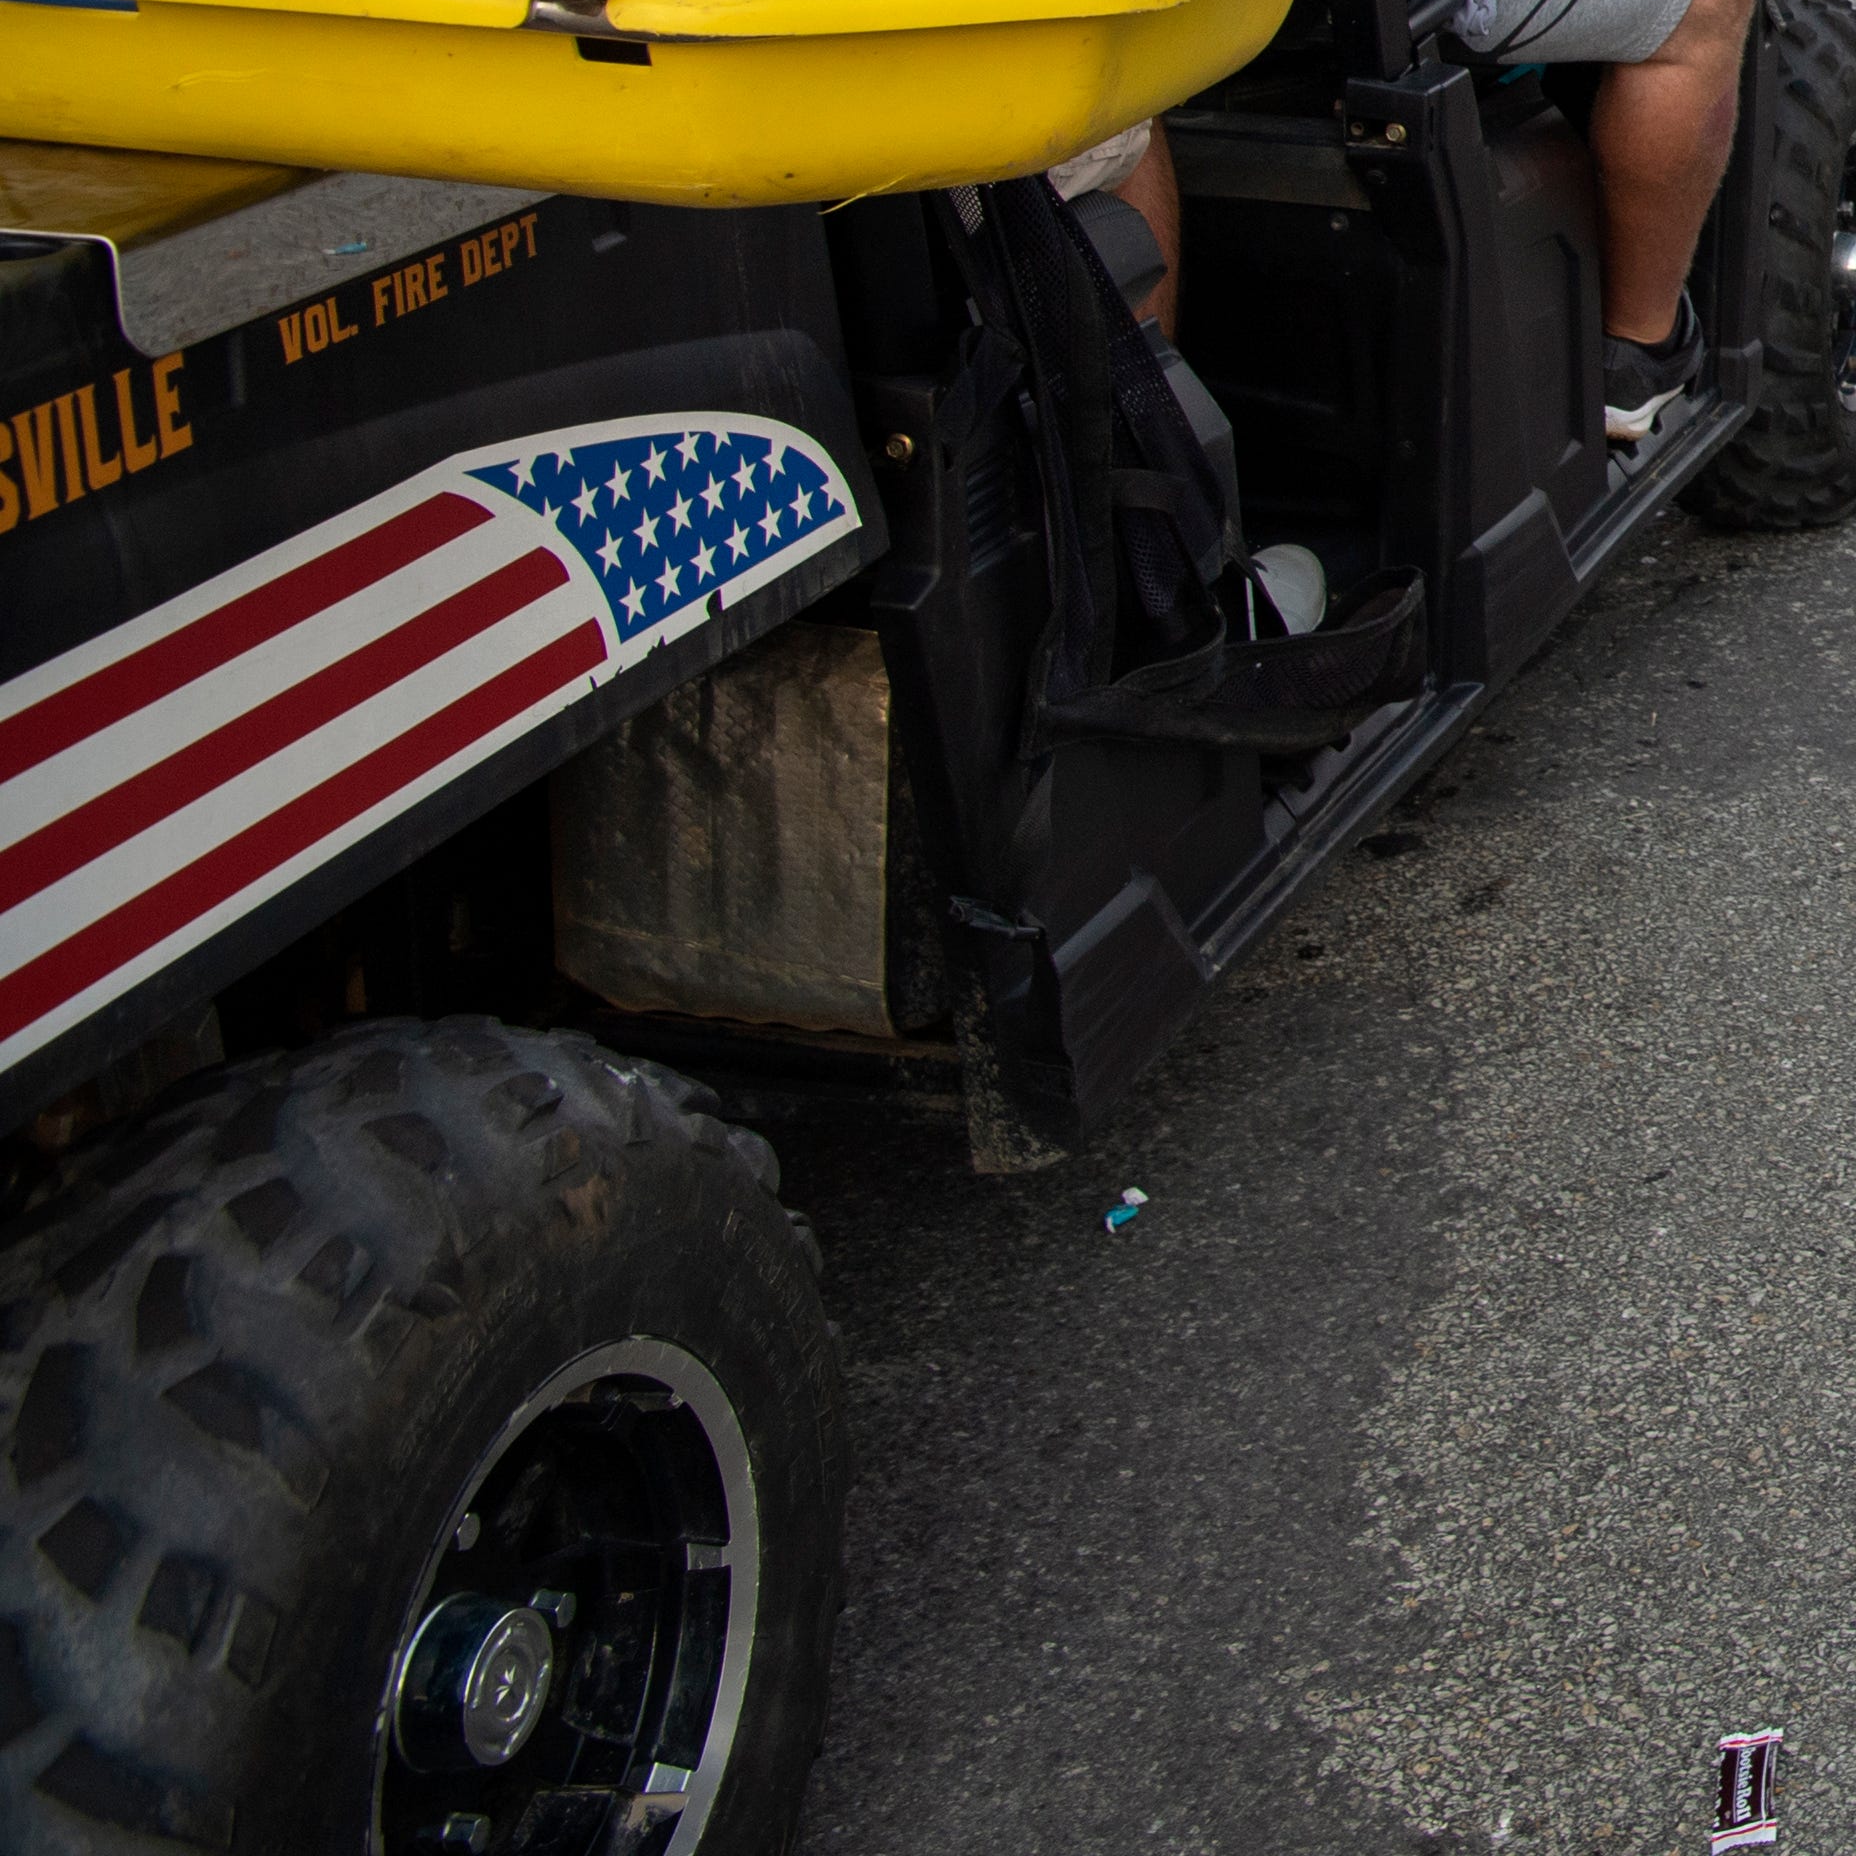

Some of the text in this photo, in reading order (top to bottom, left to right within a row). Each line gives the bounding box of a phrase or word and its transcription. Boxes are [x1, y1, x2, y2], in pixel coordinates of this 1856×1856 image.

[278, 296, 359, 366] VOL.
[371, 252, 449, 328] FIRE
[458, 212, 540, 287] DEPT
